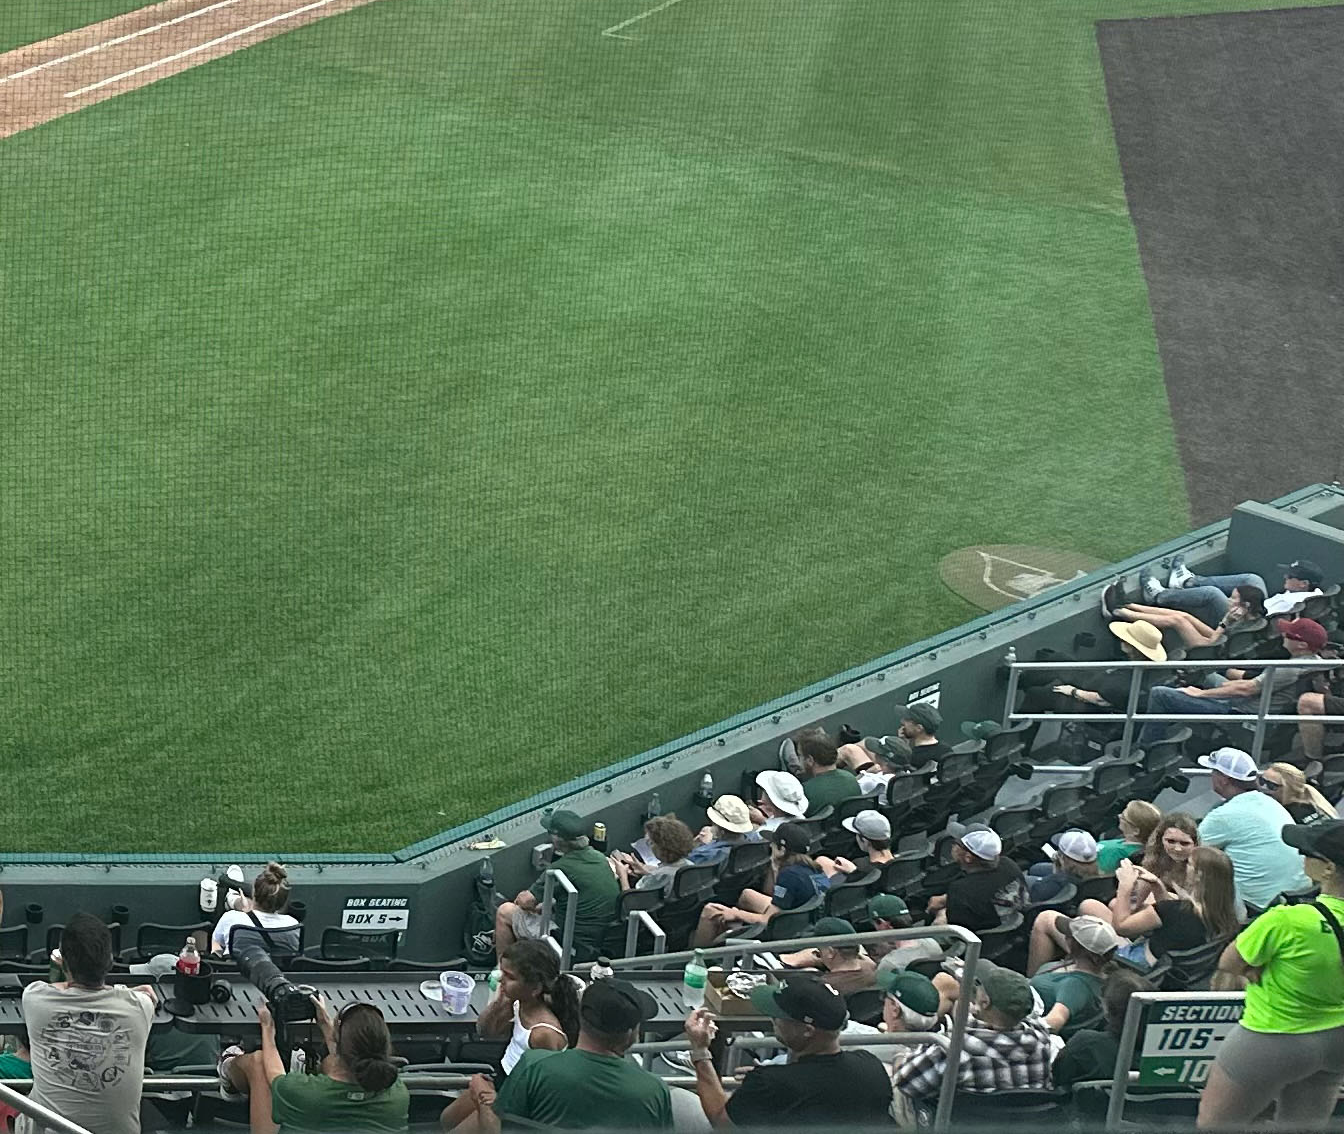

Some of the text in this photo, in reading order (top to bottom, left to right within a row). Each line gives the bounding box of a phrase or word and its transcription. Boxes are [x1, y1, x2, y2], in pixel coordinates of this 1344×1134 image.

[346, 898, 408, 907] BOX SEATING
[346, 914, 374, 924] BOX
[1160, 1005, 1243, 1021] SECTION
[1158, 1028, 1214, 1050] 105
[1178, 1059, 1212, 1082] 10
